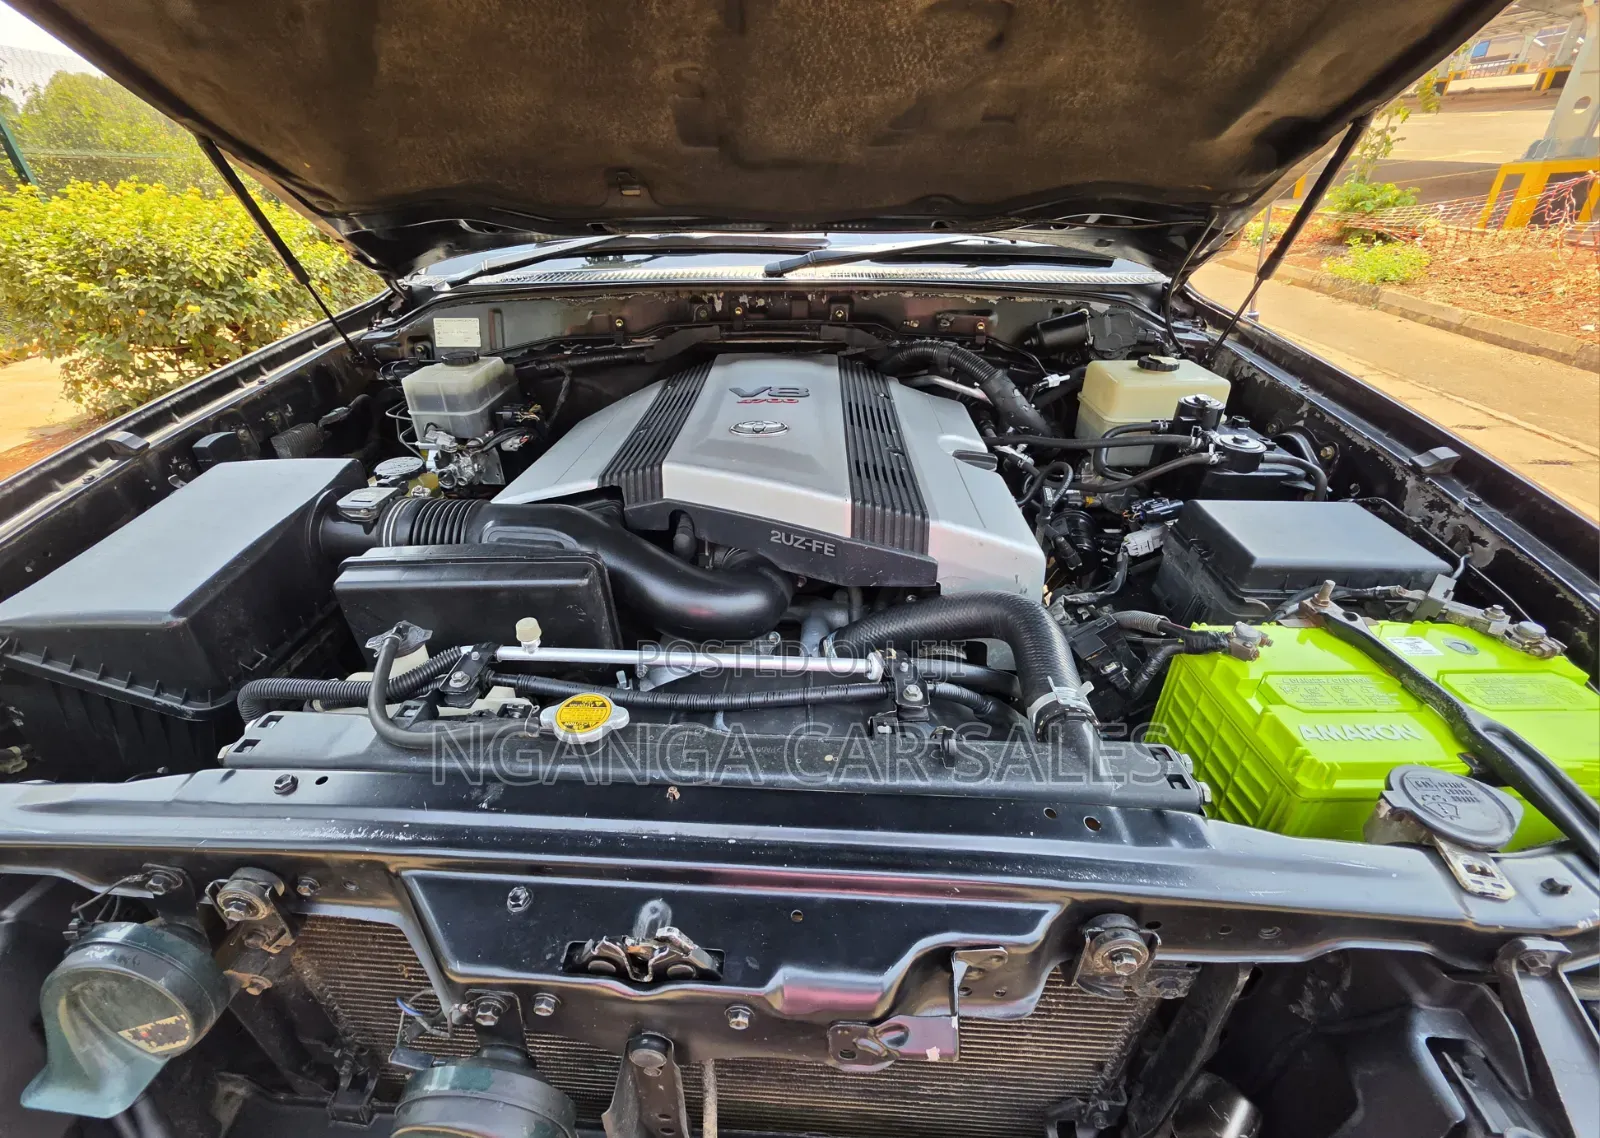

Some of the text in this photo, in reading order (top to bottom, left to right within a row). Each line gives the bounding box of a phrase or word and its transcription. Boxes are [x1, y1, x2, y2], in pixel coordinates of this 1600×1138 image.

[728, 386, 810, 398] V8
[770, 530, 836, 557] 2UZ-FE
[1299, 724, 1424, 741] AMARON
